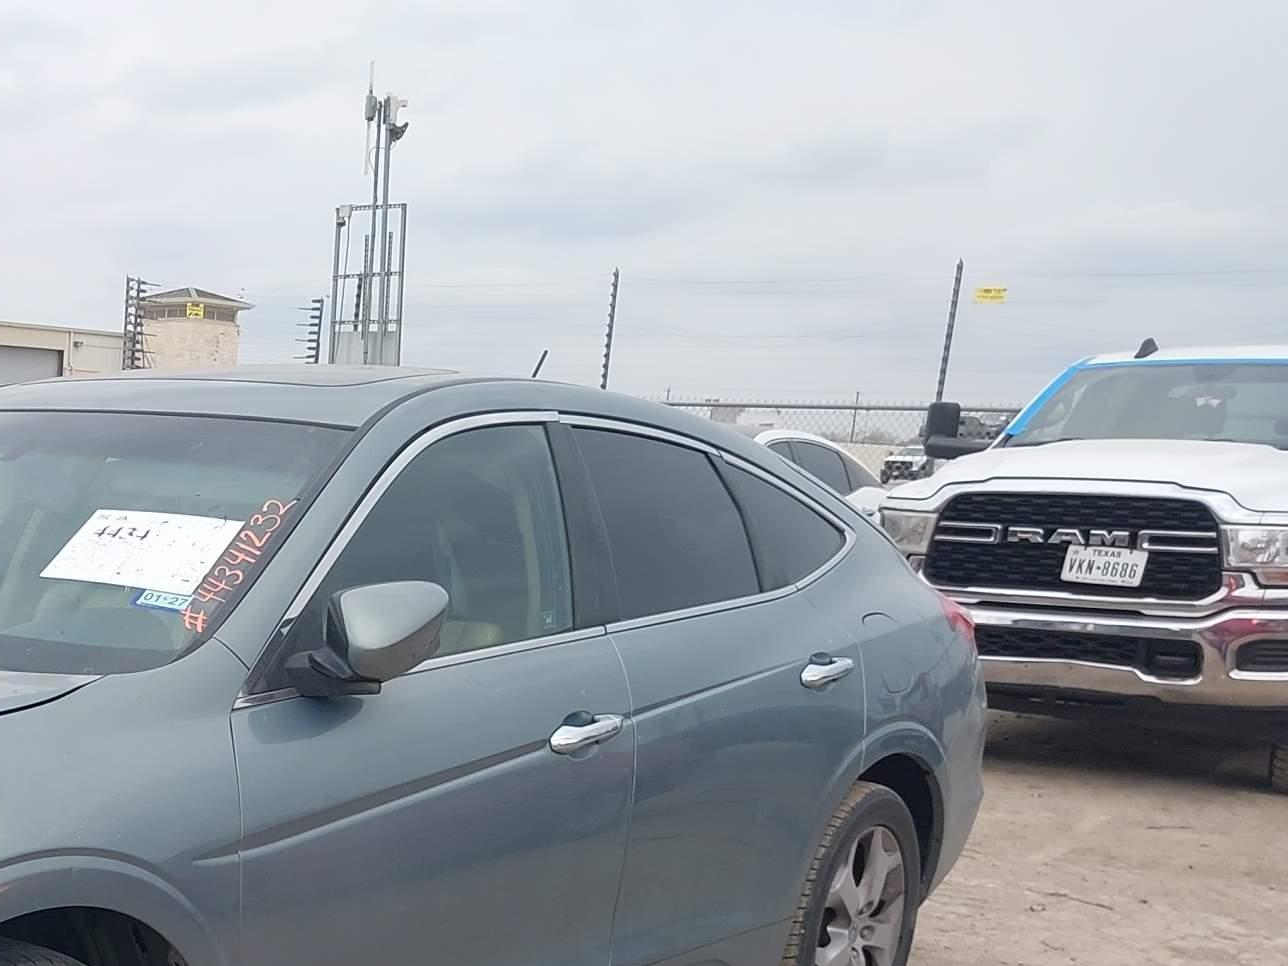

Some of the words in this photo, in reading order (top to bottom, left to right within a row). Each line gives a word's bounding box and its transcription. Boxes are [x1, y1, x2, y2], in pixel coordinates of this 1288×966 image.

[1006, 525, 1131, 547] RAM
[1092, 549, 1122, 558] TEXAS
[1068, 557, 1139, 579] VKN-8686
